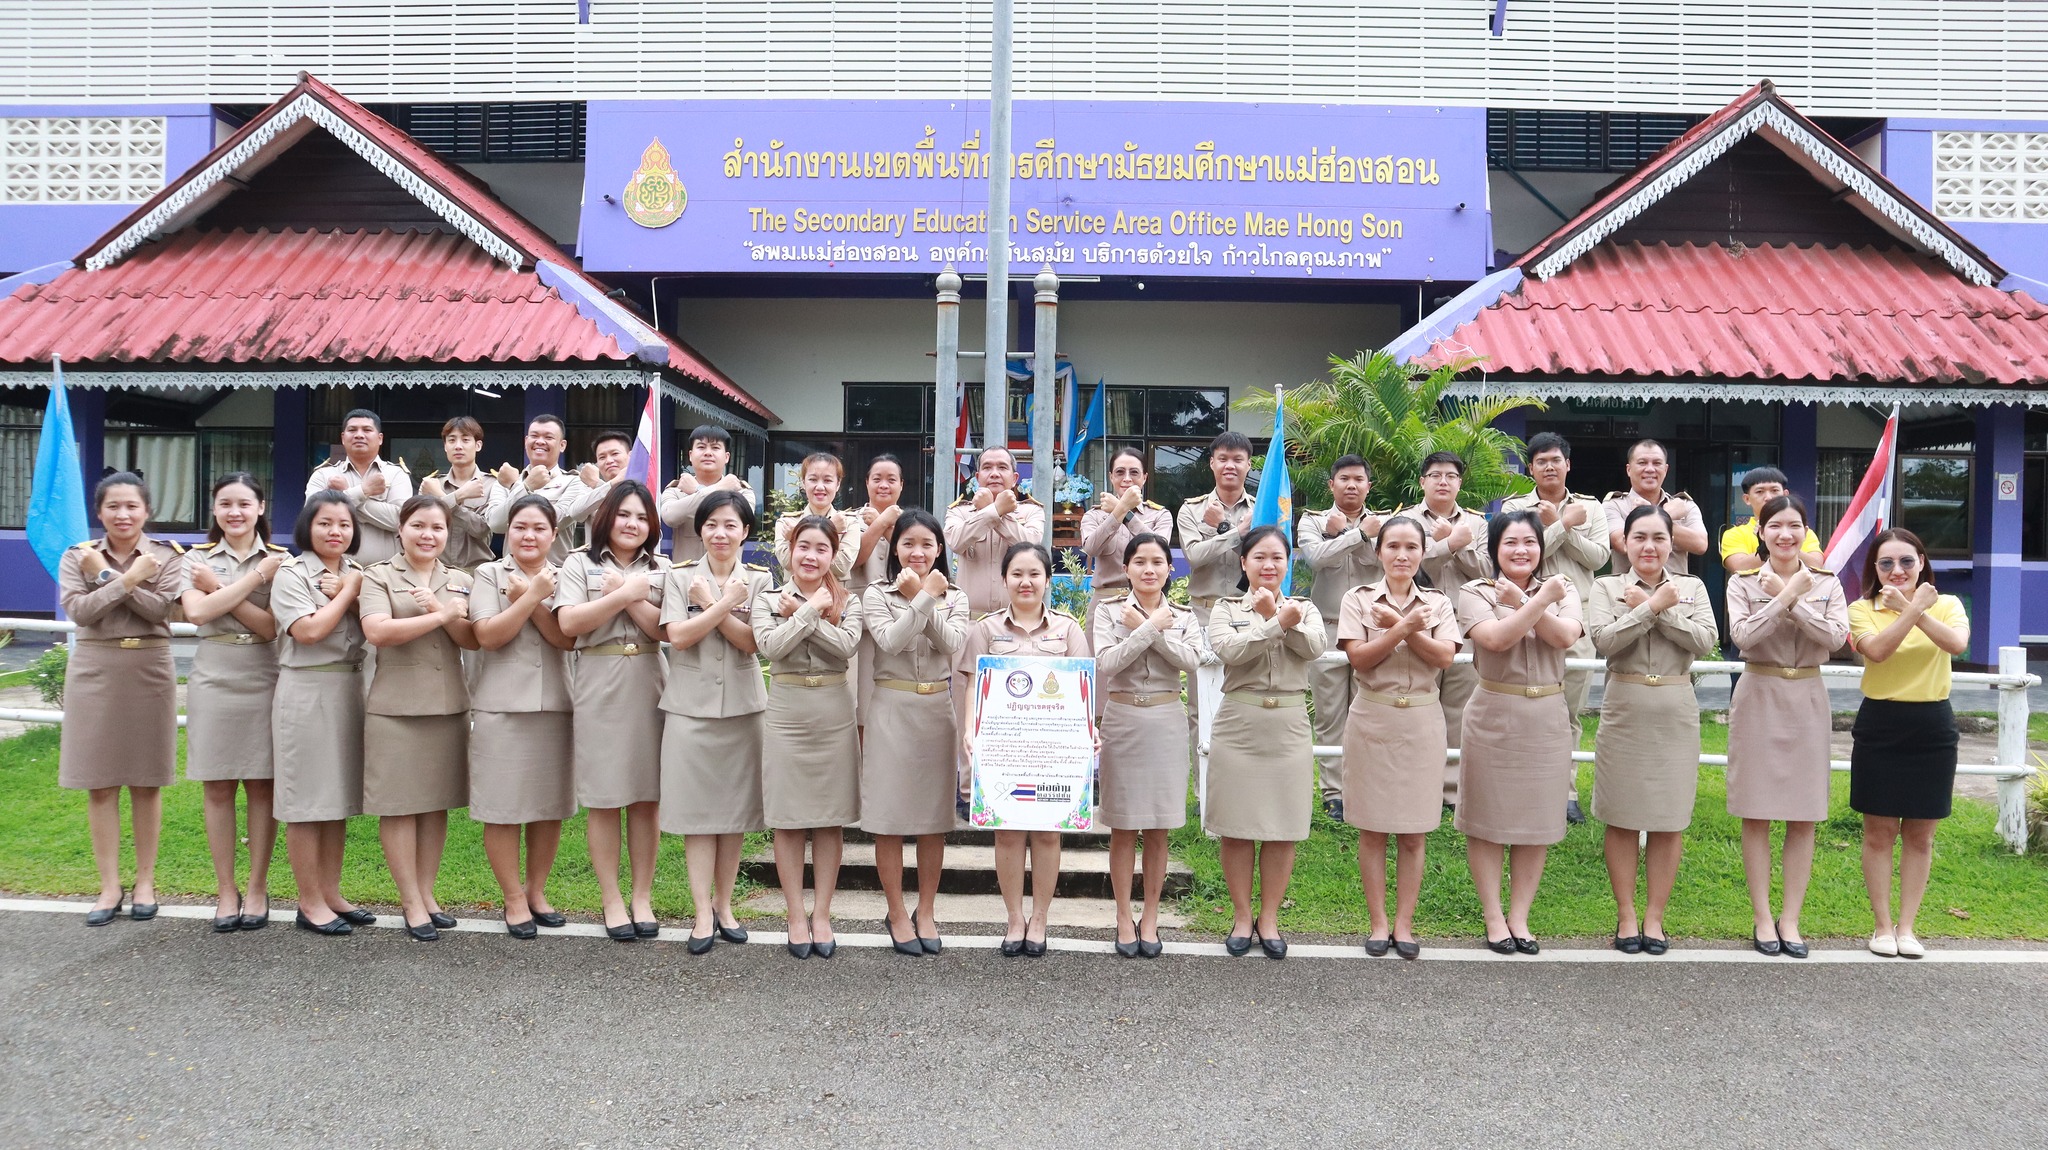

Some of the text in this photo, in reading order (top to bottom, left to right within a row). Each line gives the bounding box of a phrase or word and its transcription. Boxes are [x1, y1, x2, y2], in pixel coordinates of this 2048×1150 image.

[749, 207, 1403, 244] The Secondary Educatn Service Area Office Mae Hong Son
[743, 240, 1392, 275] “สพม.แม่ฮ่องสอน องค์กันสมัย บริการด้วยใจ ก้าวไกลคุณภาพ”
